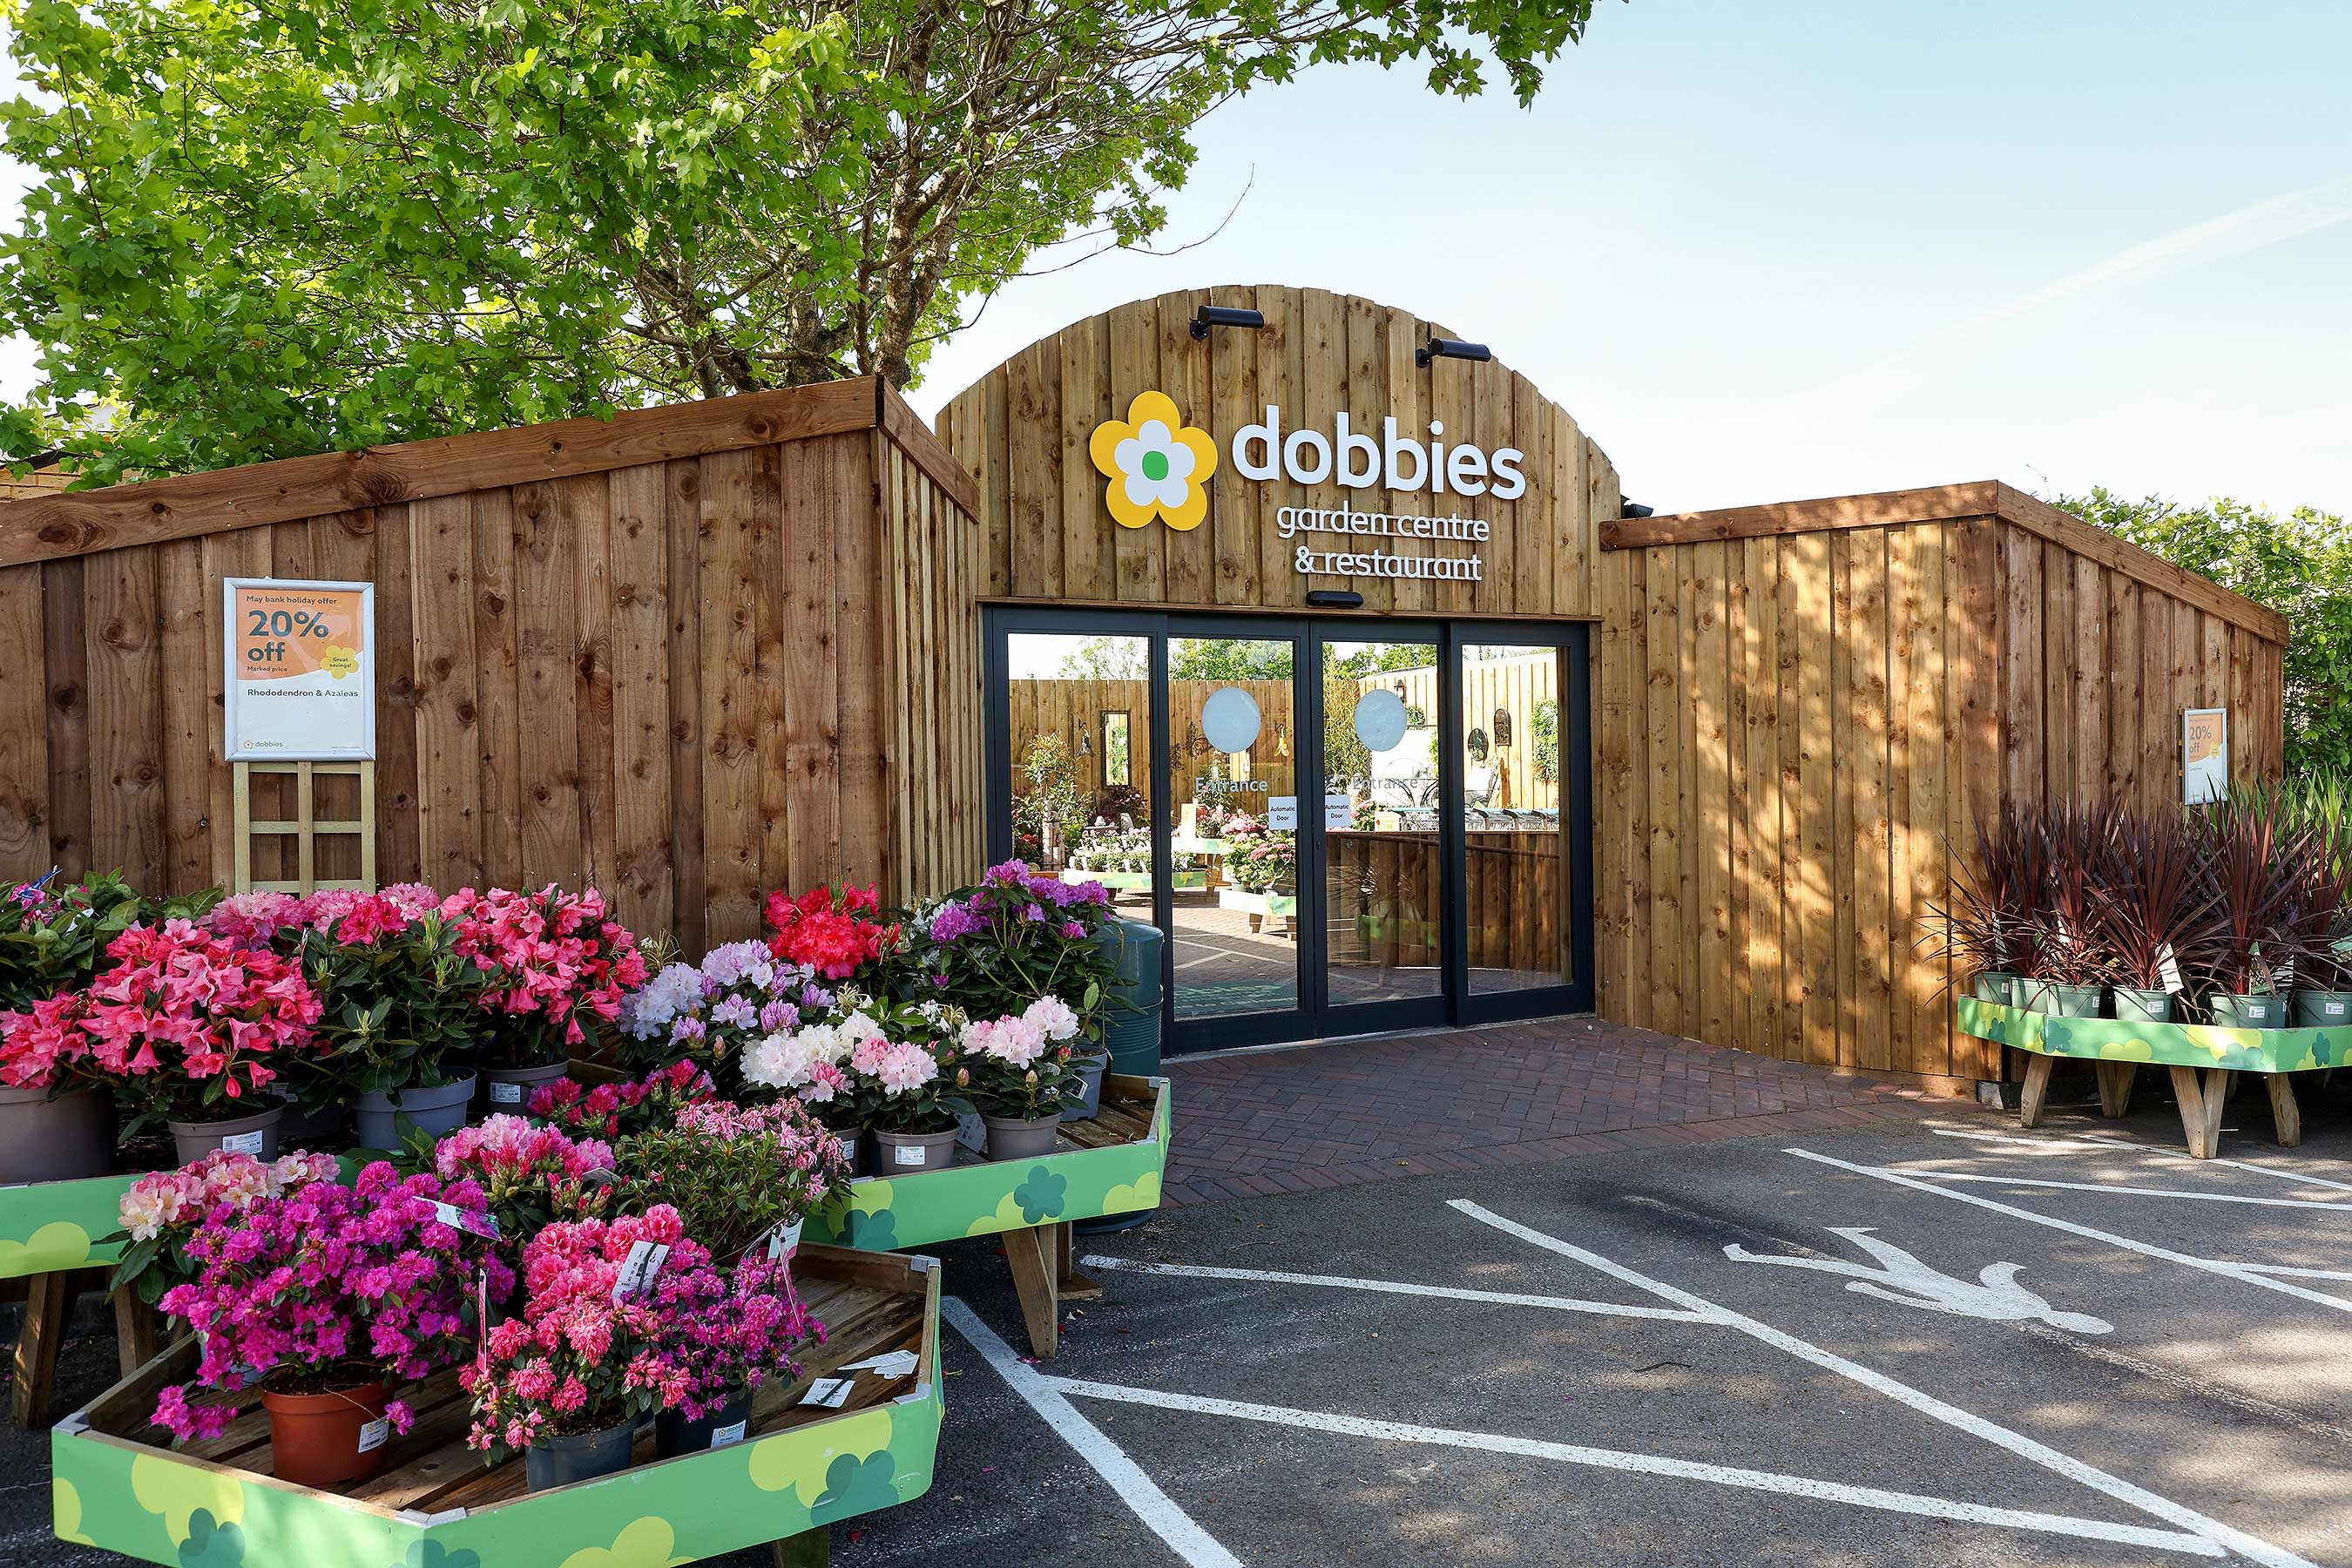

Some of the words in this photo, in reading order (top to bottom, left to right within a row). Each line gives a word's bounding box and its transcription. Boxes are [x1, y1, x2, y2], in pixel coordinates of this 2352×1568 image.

[1232, 404, 1527, 500] dobbies
[1276, 500, 1389, 539] garden
[1396, 511, 1490, 542] centre
[1294, 545, 1316, 574] &
[1324, 548, 1484, 581] restaurant
[246, 595, 262, 604] May
[287, 596, 316, 605] holiday
[247, 609, 329, 639] 20%
[247, 641, 286, 662] off
[247, 688, 314, 698] Rhododendron
[324, 689, 360, 698] Azaleas
[2189, 726, 2212, 740] 20%
[2189, 743, 2200, 754] off
[1194, 776, 1269, 793] Entrance
